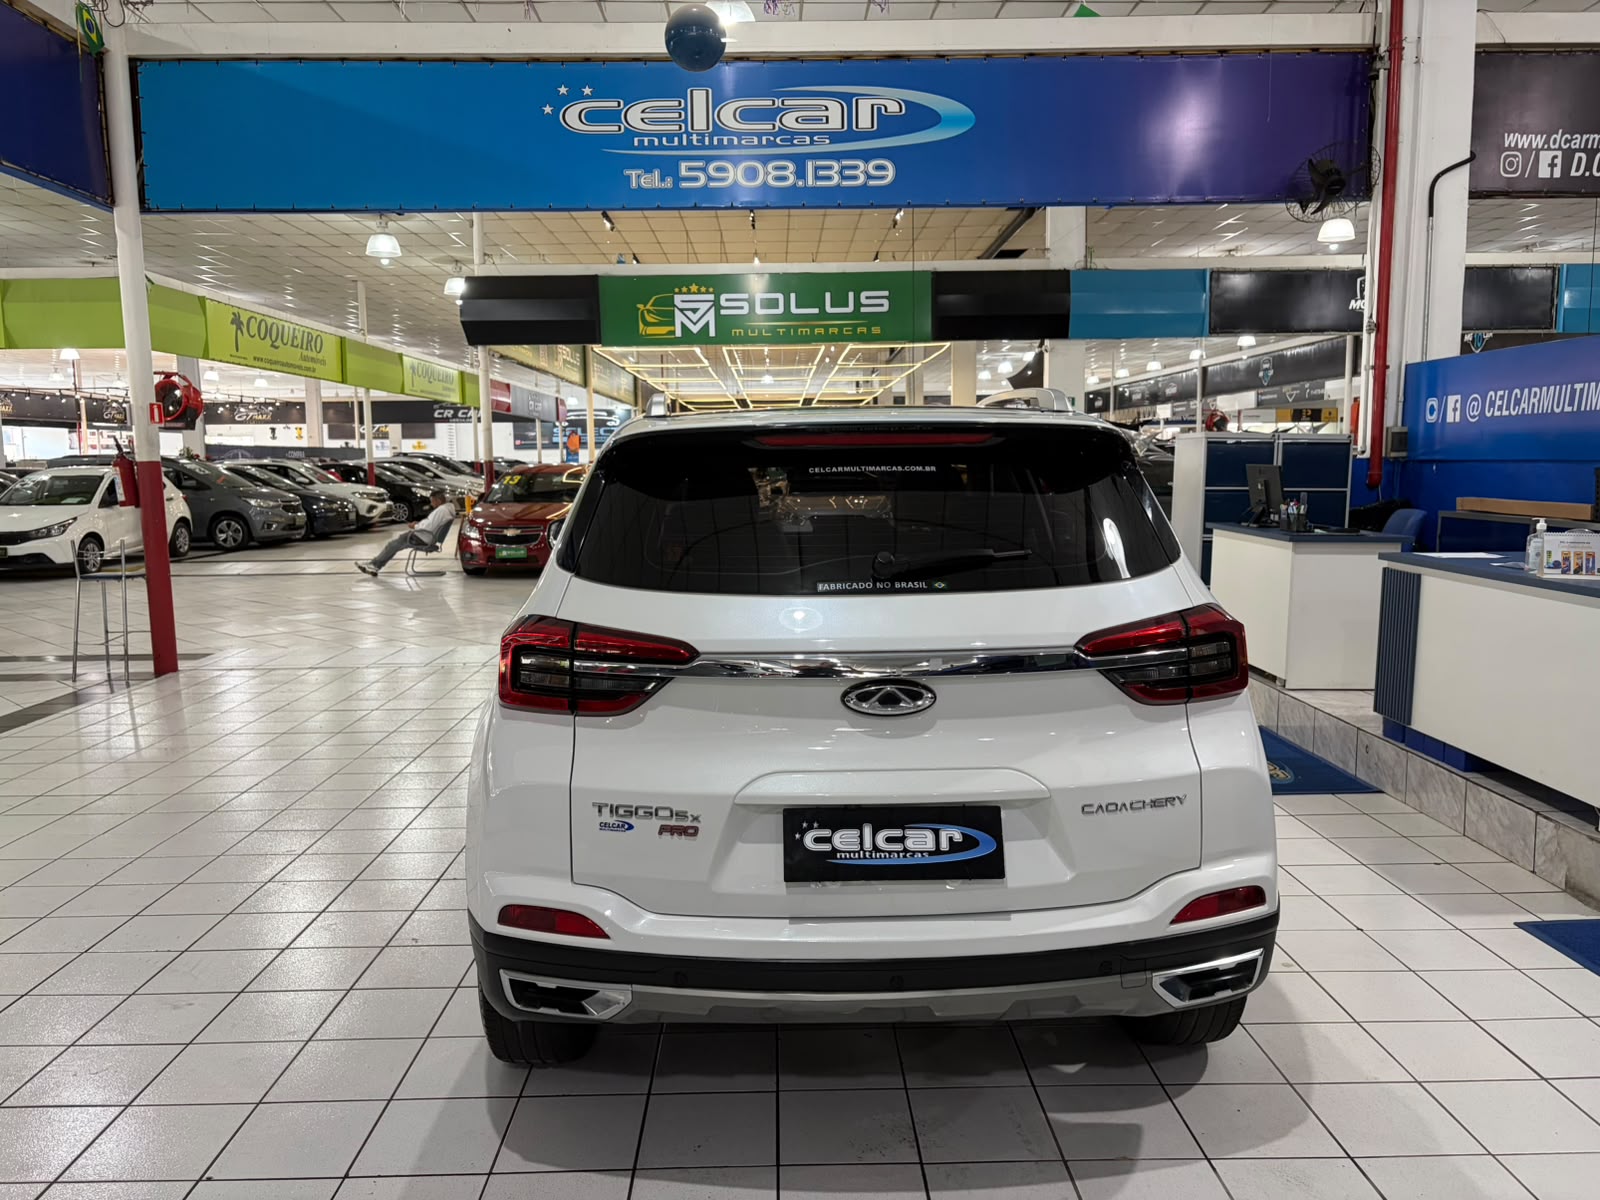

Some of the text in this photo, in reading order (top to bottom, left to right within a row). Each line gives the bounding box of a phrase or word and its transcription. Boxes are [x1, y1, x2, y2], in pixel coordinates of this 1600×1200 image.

[560, 87, 905, 134] celcar
[633, 134, 831, 147] multimarcas
[678, 159, 898, 189] 5908.1339
[719, 290, 890, 315] SOLUS
[246, 315, 324, 354] COQUEIRO
[731, 326, 882, 337] MULTIMARCAS
[416, 362, 455, 385] COQUEIRO
[434, 409, 454, 418] CR
[808, 465, 937, 473] CELCARMULTIMARCAS.COM.BR
[503, 475, 521, 485] 13
[817, 581, 873, 592] FABRICADO
[895, 581, 928, 589] BRASIL
[599, 821, 626, 829] CELCAR
[658, 824, 700, 837] PRO
[803, 823, 963, 851] celcar
[837, 850, 929, 859] multimarcas
